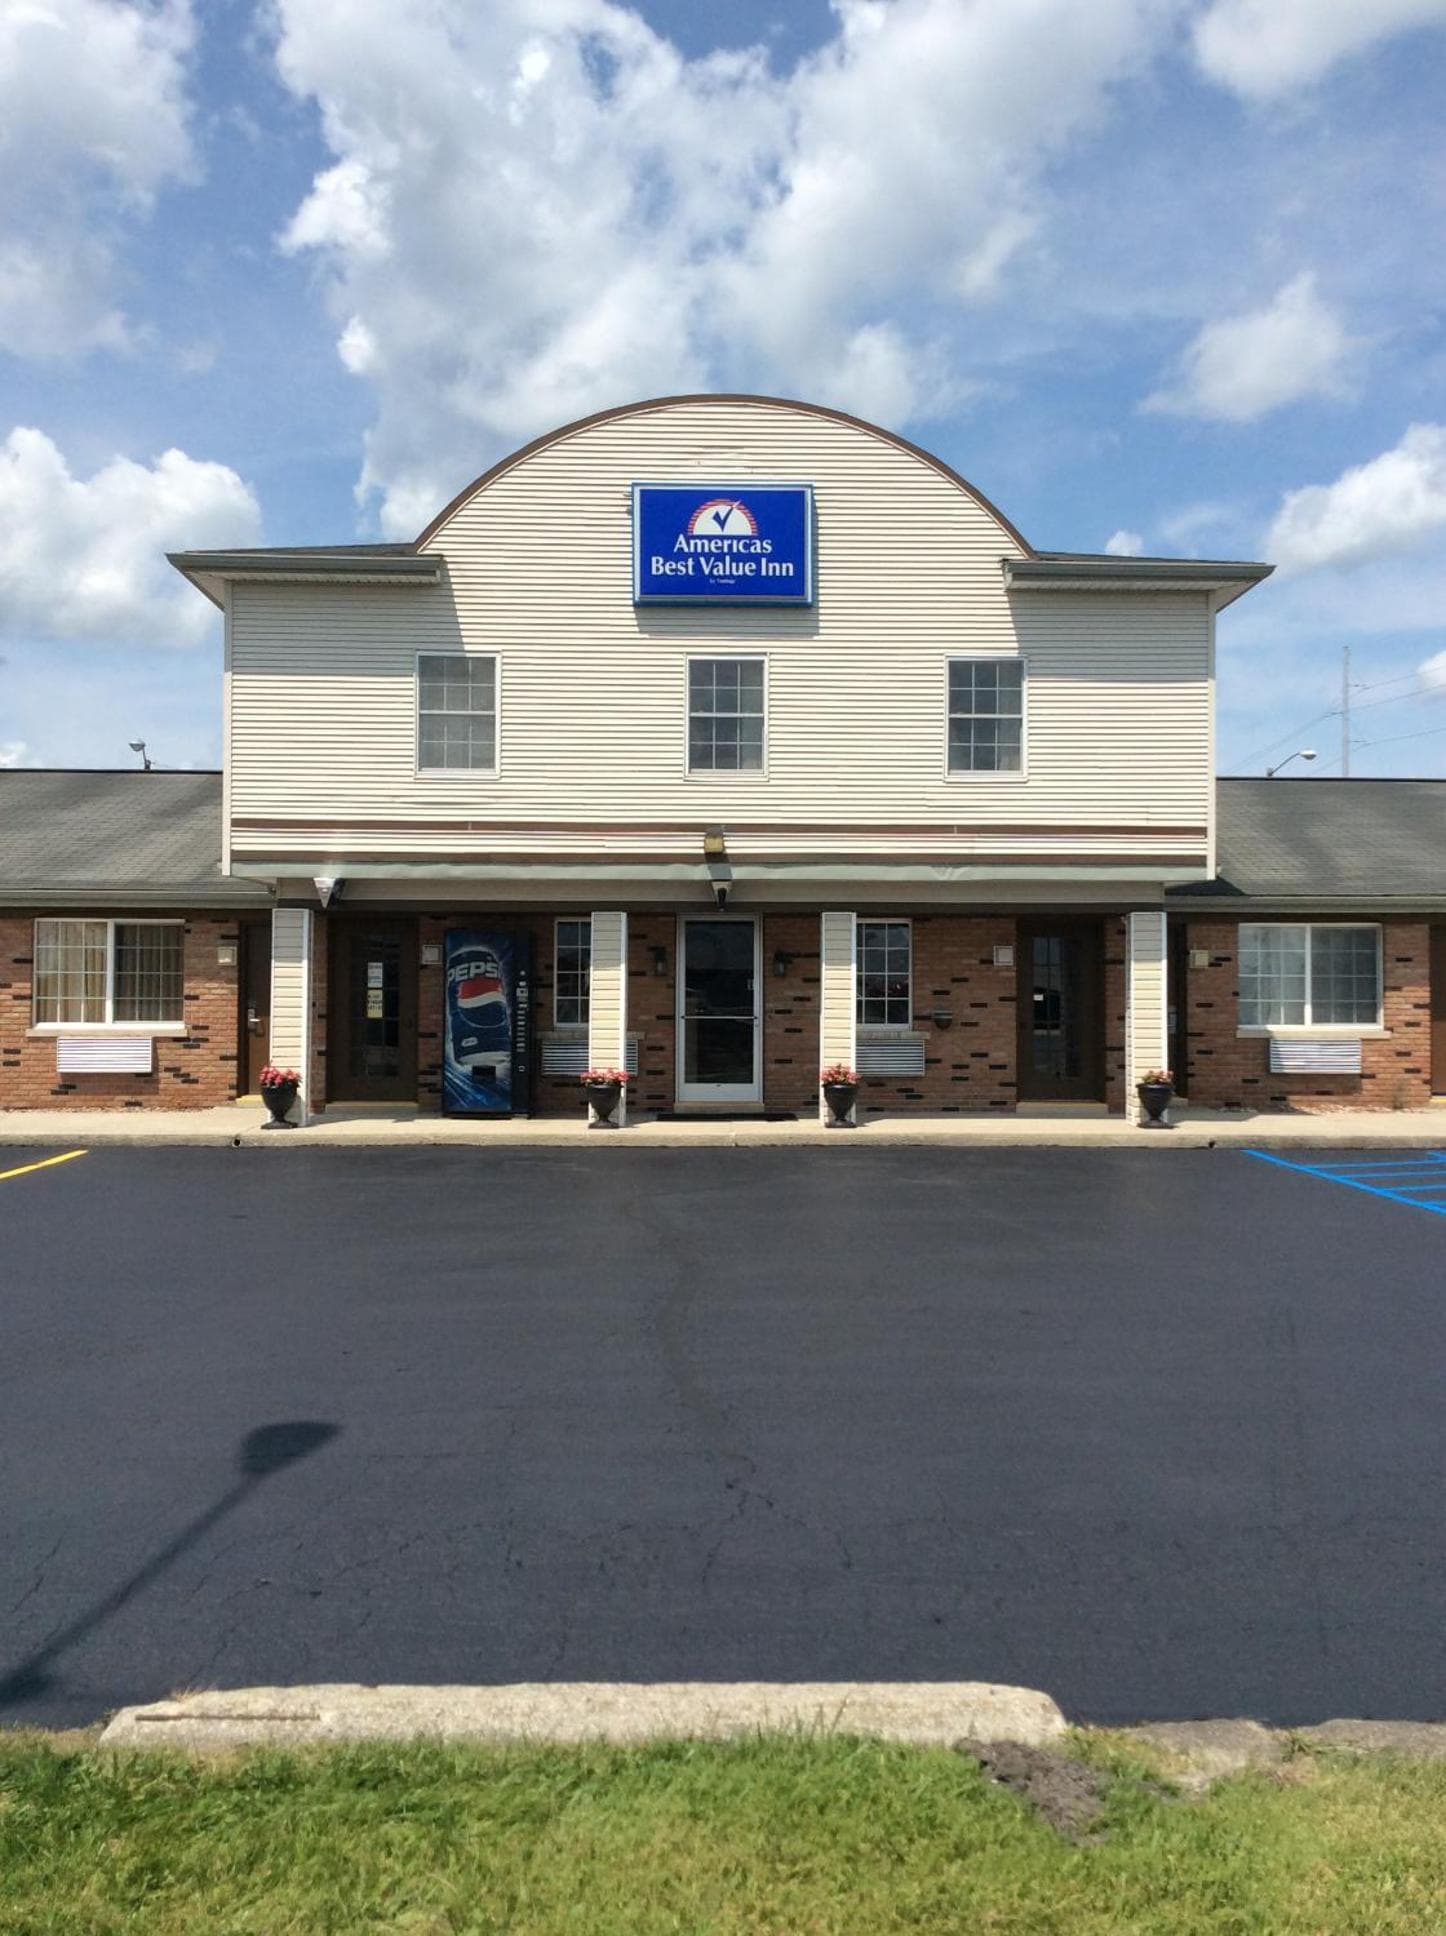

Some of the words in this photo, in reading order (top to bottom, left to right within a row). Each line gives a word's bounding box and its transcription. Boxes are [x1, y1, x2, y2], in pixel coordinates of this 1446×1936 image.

[674, 534, 772, 553] Americas
[651, 556, 695, 576] Best
[699, 556, 756, 576] Value
[761, 558, 794, 576] Inn
